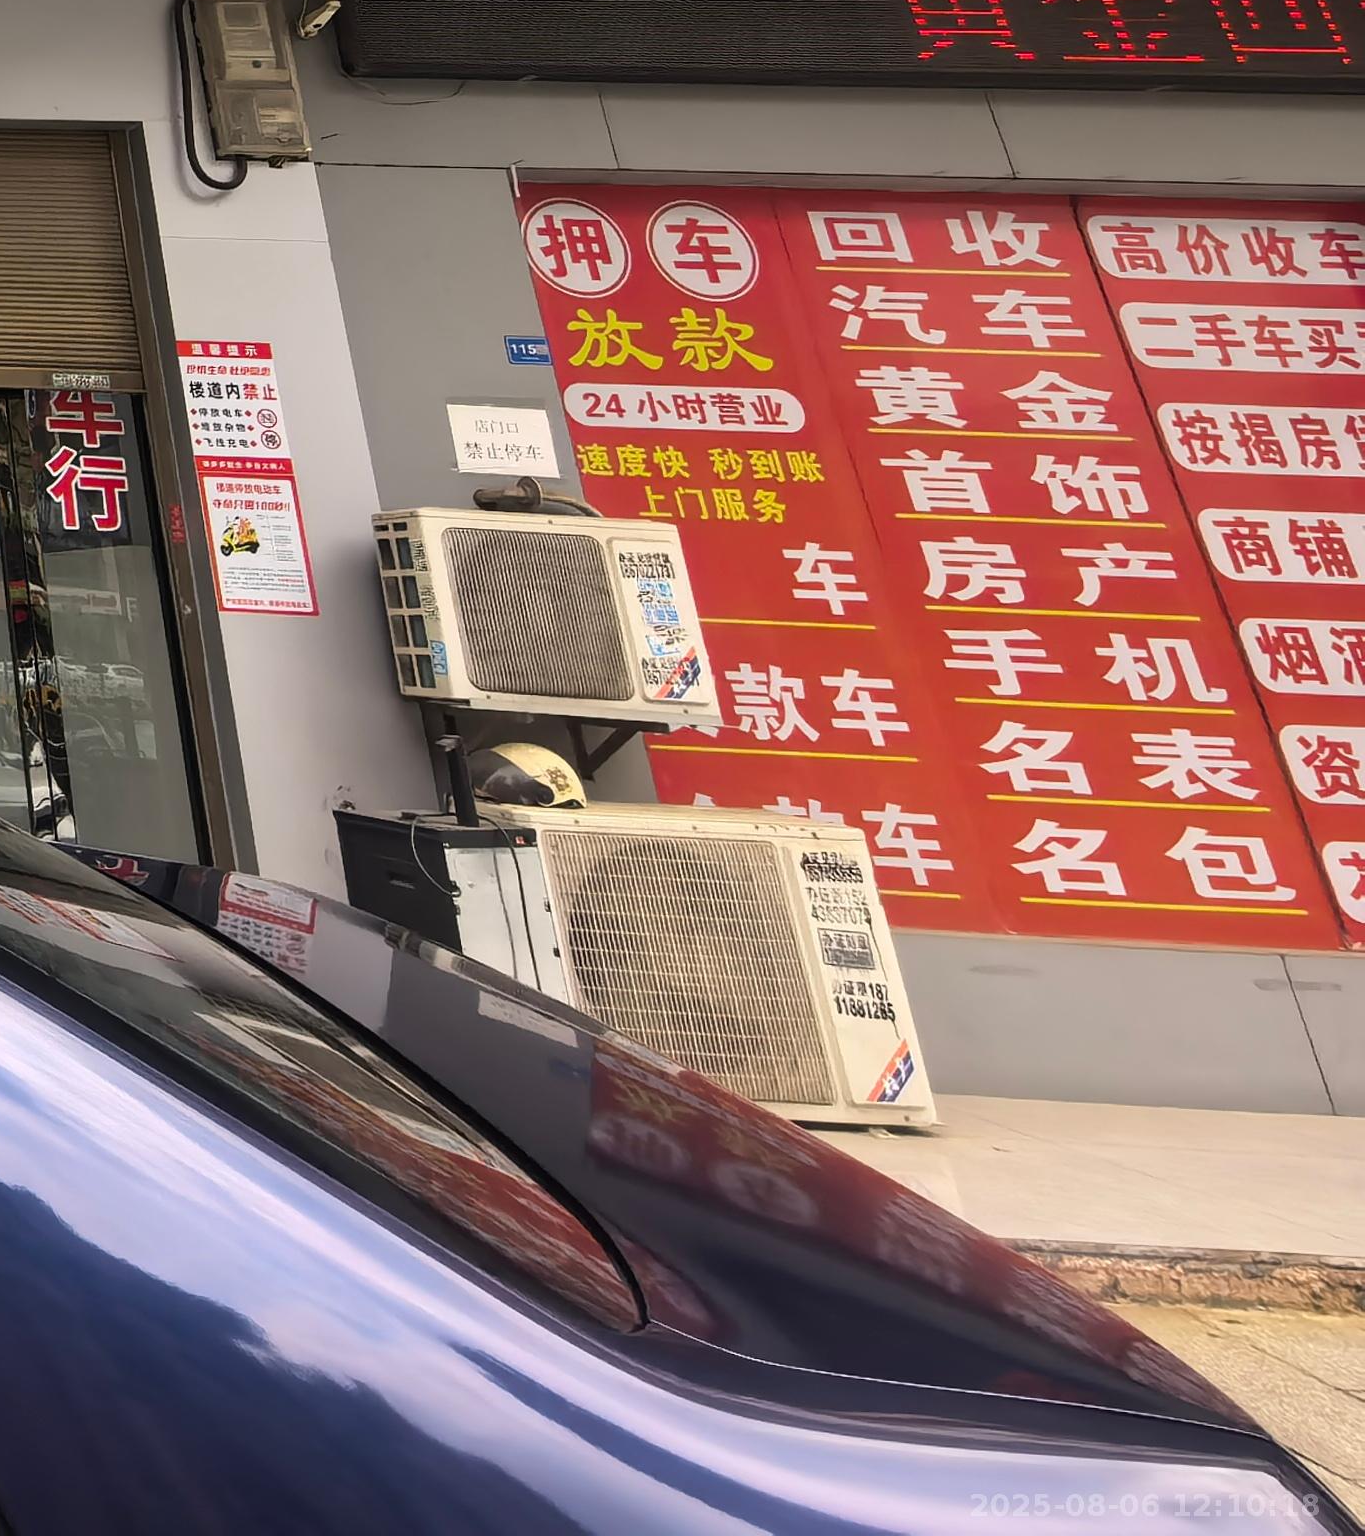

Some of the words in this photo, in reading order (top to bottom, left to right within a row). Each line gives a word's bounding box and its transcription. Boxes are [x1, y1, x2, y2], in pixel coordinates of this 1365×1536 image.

[536, 214, 742, 284] 押车
[807, 210, 1062, 269] 回收
[1101, 221, 1365, 281] 高价收车
[566, 307, 774, 372] 放款
[828, 284, 1087, 348] 汽车
[1137, 314, 1365, 370] 二手车买
[189, 380, 278, 400] 楼道内禁止
[855, 366, 1120, 432] 黄金
[45, 389, 129, 531] 车行
[464, 441, 545, 462] 禁止停车
[576, 443, 691, 480] 速度快
[708, 447, 826, 484] 秒到账
[879, 449, 1151, 519] 首饰
[639, 484, 787, 524] 上门服务
[919, 536, 1178, 608] 房产
[943, 628, 1229, 704] 手机
[978, 720, 1262, 802] 名表
[1012, 817, 1297, 902] 名包
